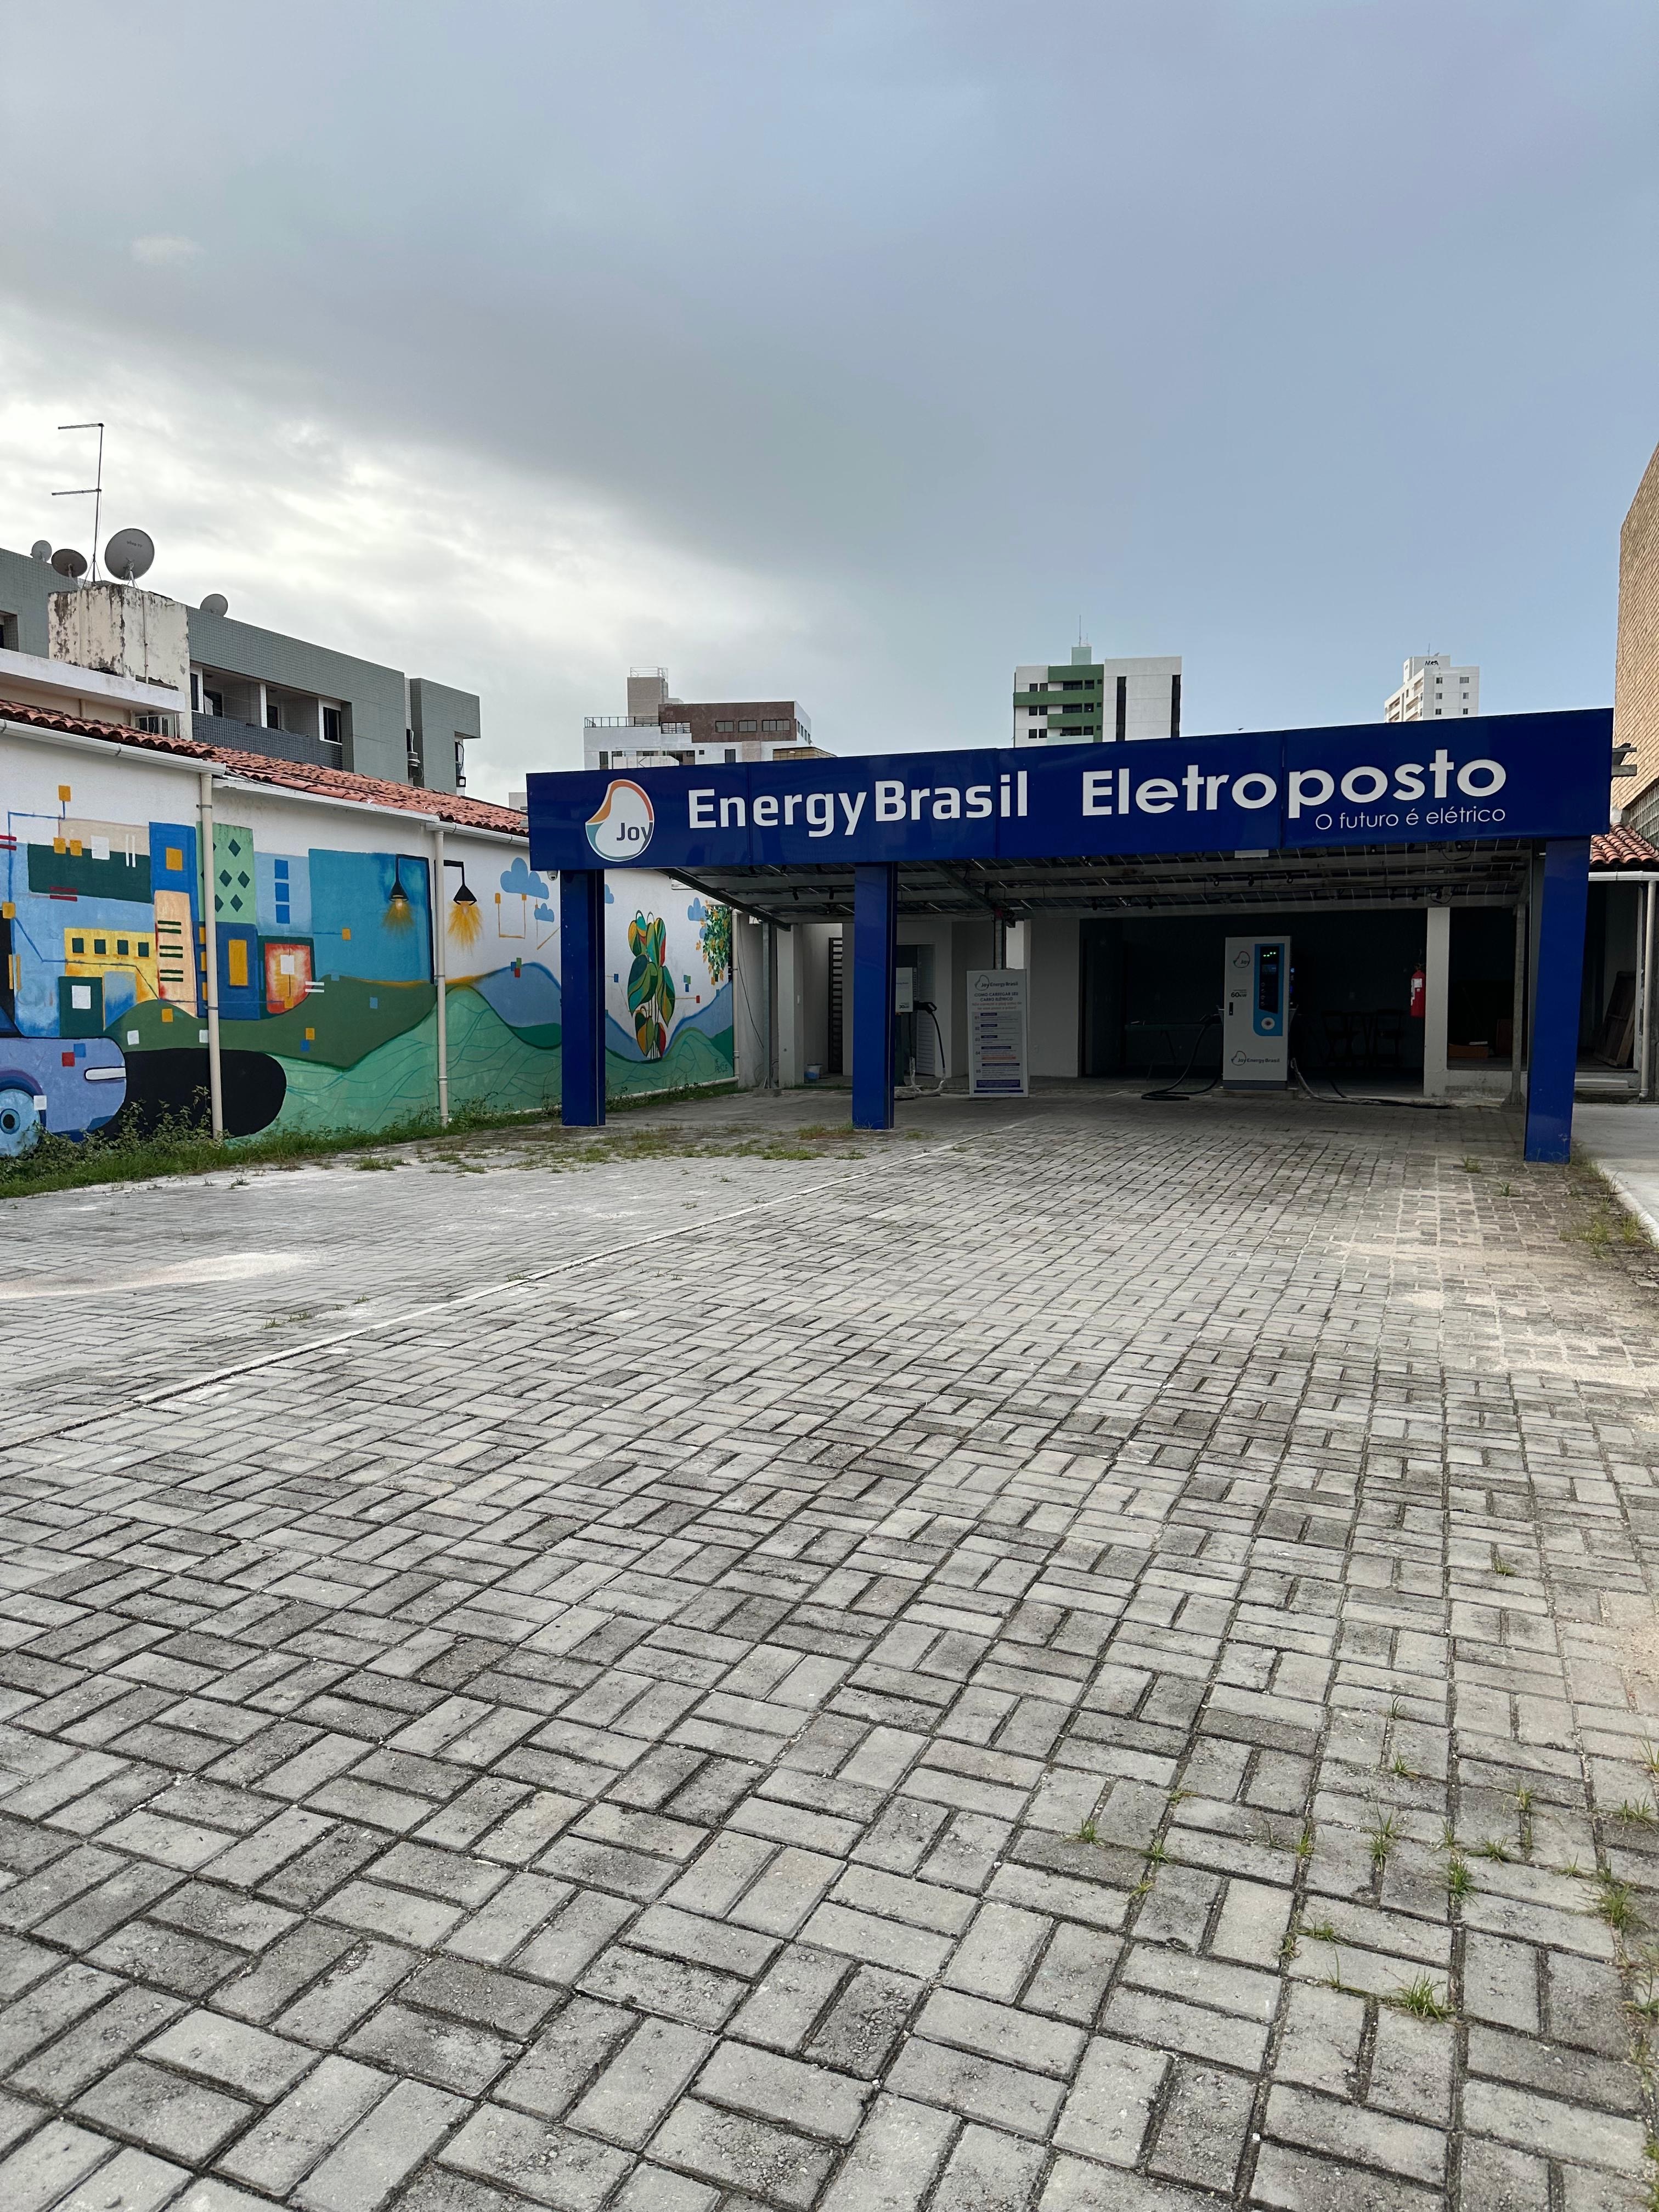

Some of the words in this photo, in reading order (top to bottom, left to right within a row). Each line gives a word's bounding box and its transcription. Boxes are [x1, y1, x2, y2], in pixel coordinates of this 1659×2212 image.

[1082, 749, 1506, 819] Eletroposto
[1315, 814, 1333, 830] O
[1339, 812, 1399, 828] futuro
[1406, 808, 1419, 826] é
[1426, 805, 1506, 825] elétrico
[616, 822, 653, 851] Joy
